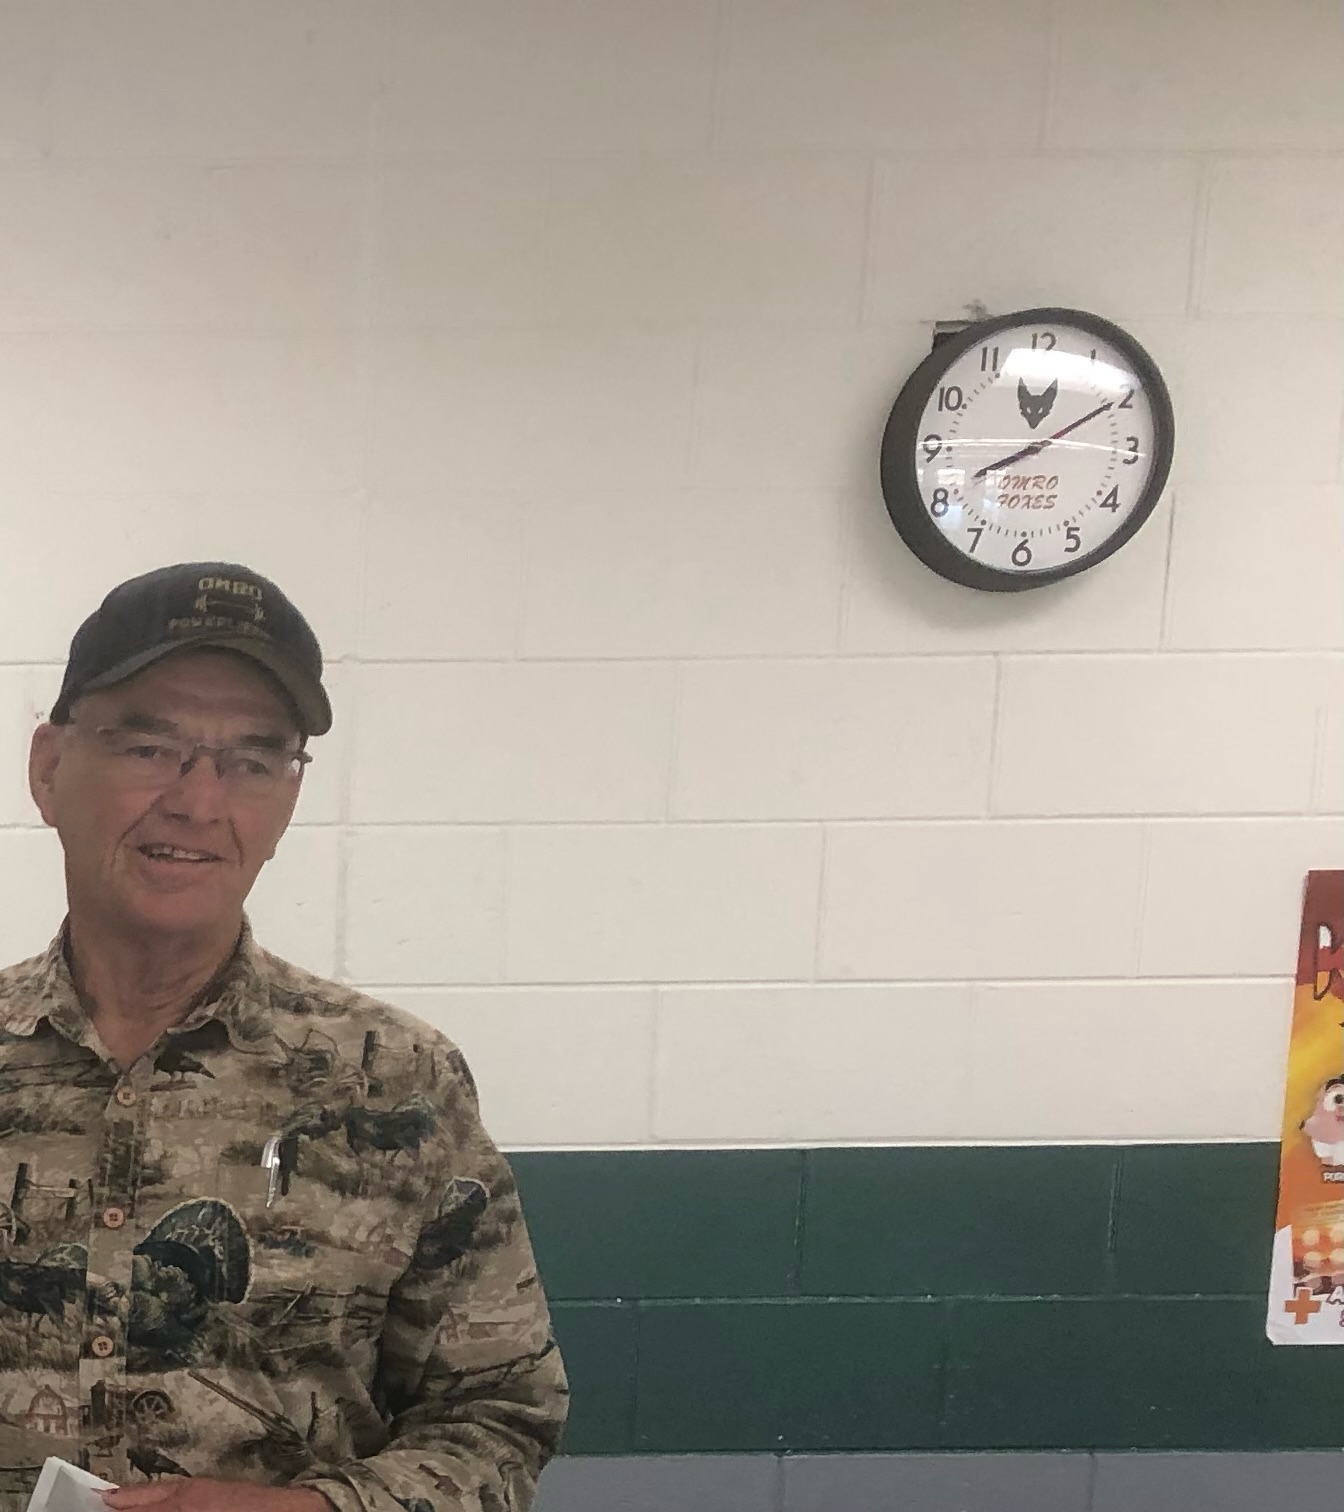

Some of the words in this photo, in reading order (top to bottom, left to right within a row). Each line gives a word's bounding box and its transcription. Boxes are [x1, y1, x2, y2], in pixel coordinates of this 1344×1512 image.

[981, 346, 999, 372] 11
[938, 386, 962, 412] 10
[923, 434, 943, 464] 9
[1122, 436, 1139, 465] 3
[930, 487, 950, 518] 8
[1099, 484, 1121, 513] 4
[967, 527, 985, 554] 7
[1011, 538, 1033, 568] 6
[1064, 526, 1081, 553] 5
